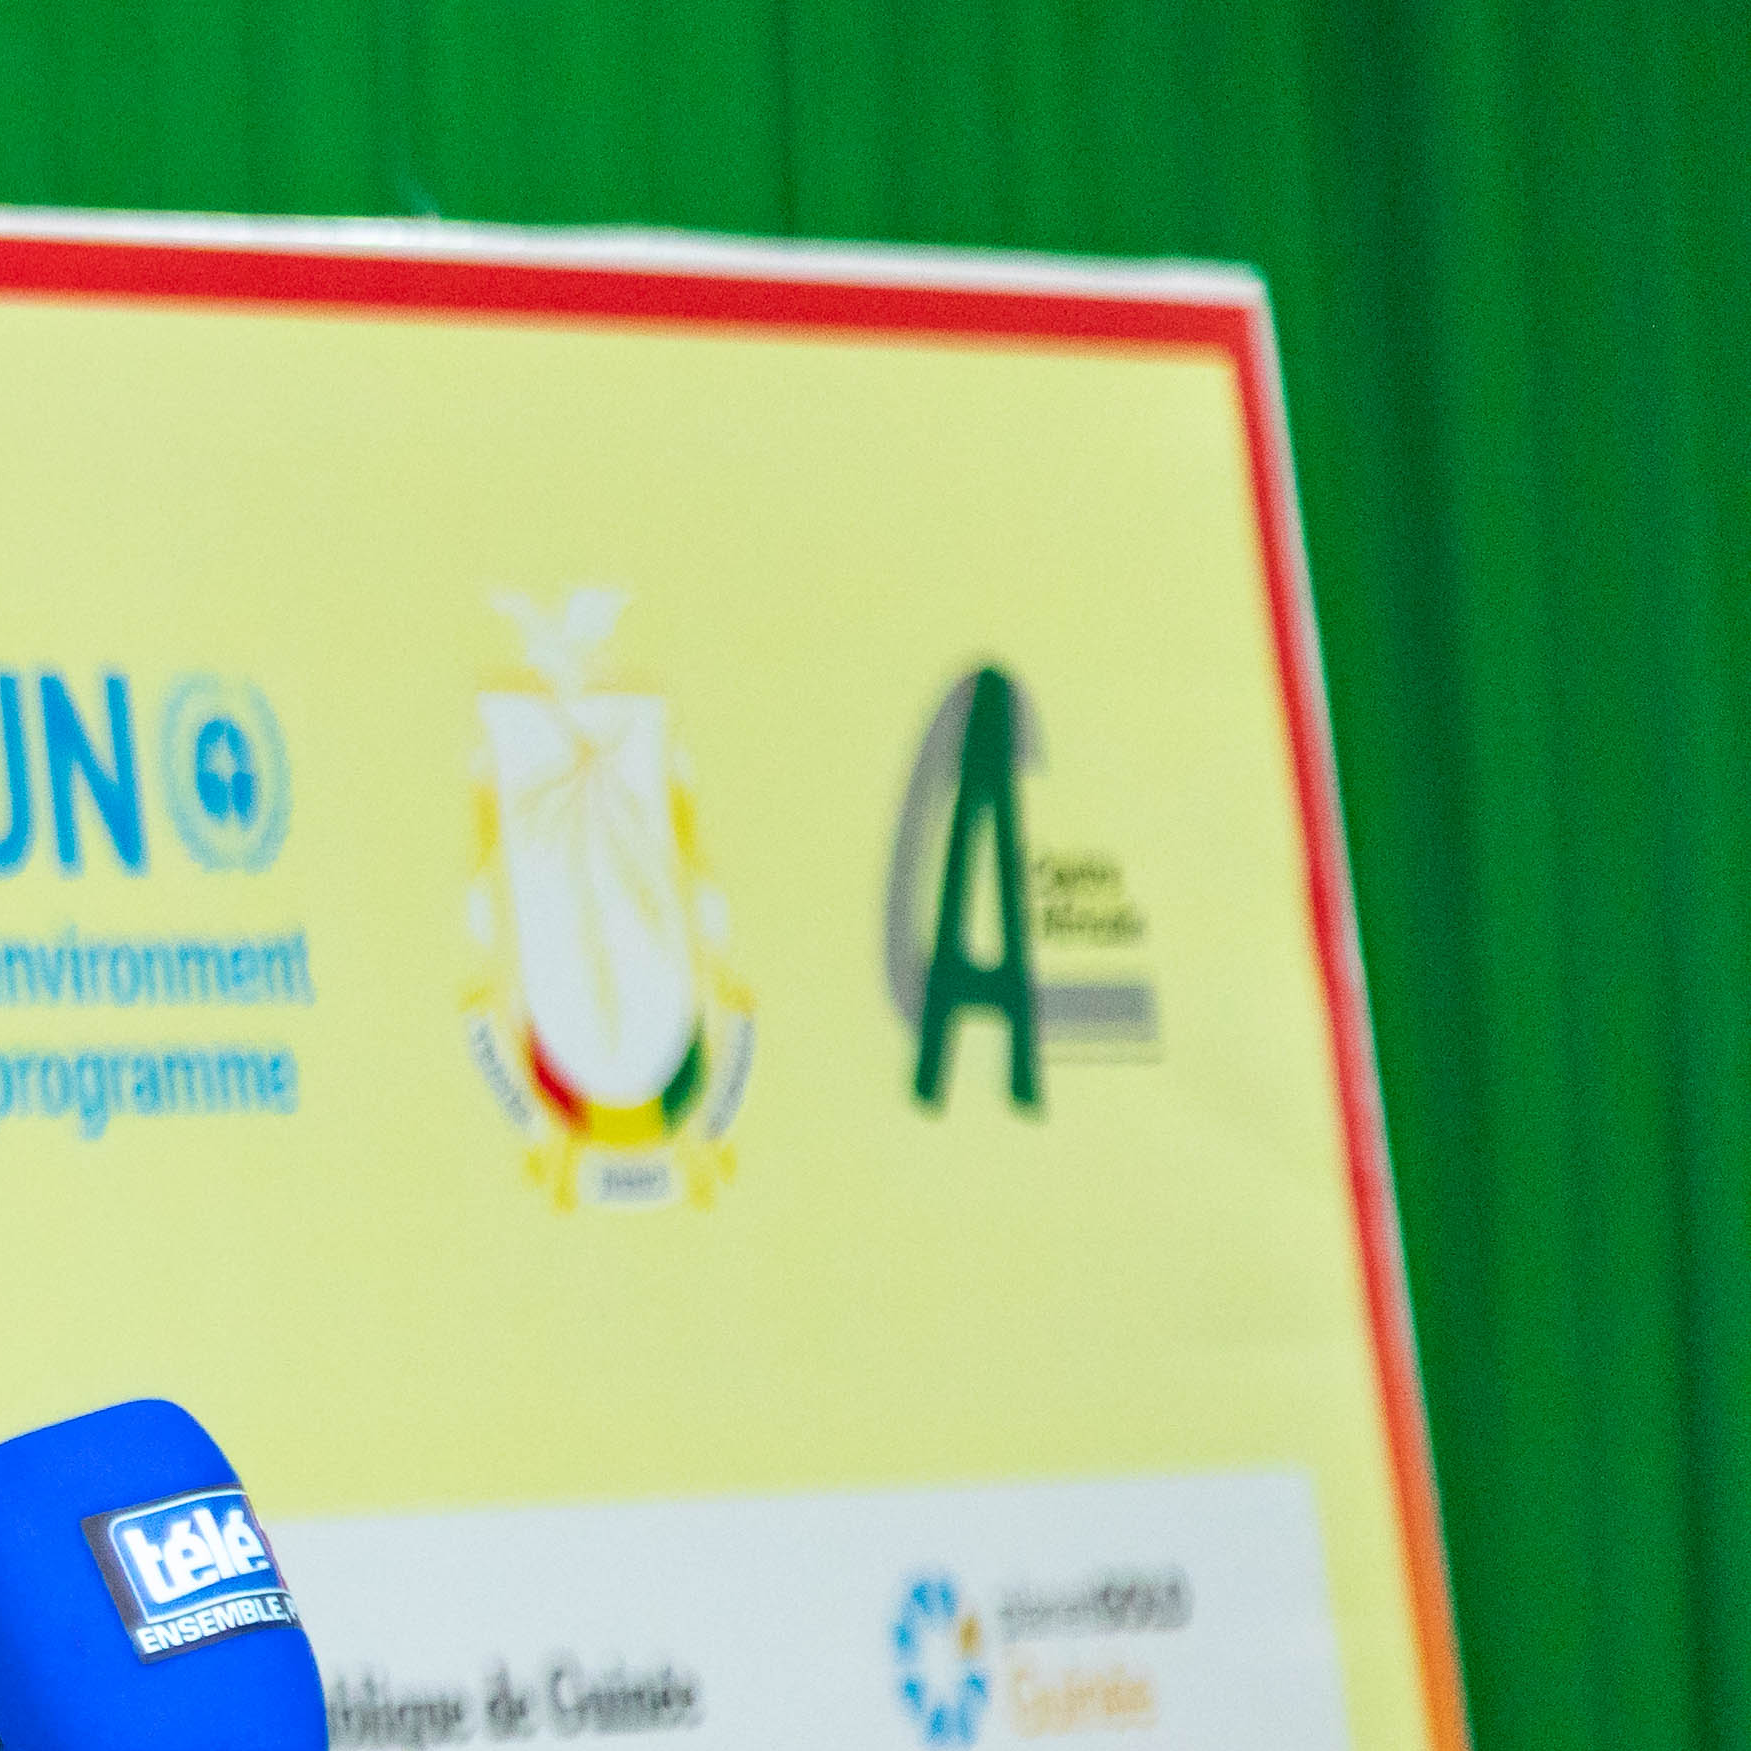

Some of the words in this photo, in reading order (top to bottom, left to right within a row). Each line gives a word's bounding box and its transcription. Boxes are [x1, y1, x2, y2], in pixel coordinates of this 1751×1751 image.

[122, 1506, 271, 1605] télé
[484, 1657, 532, 1747] de
[546, 1647, 704, 1740] Guinée
